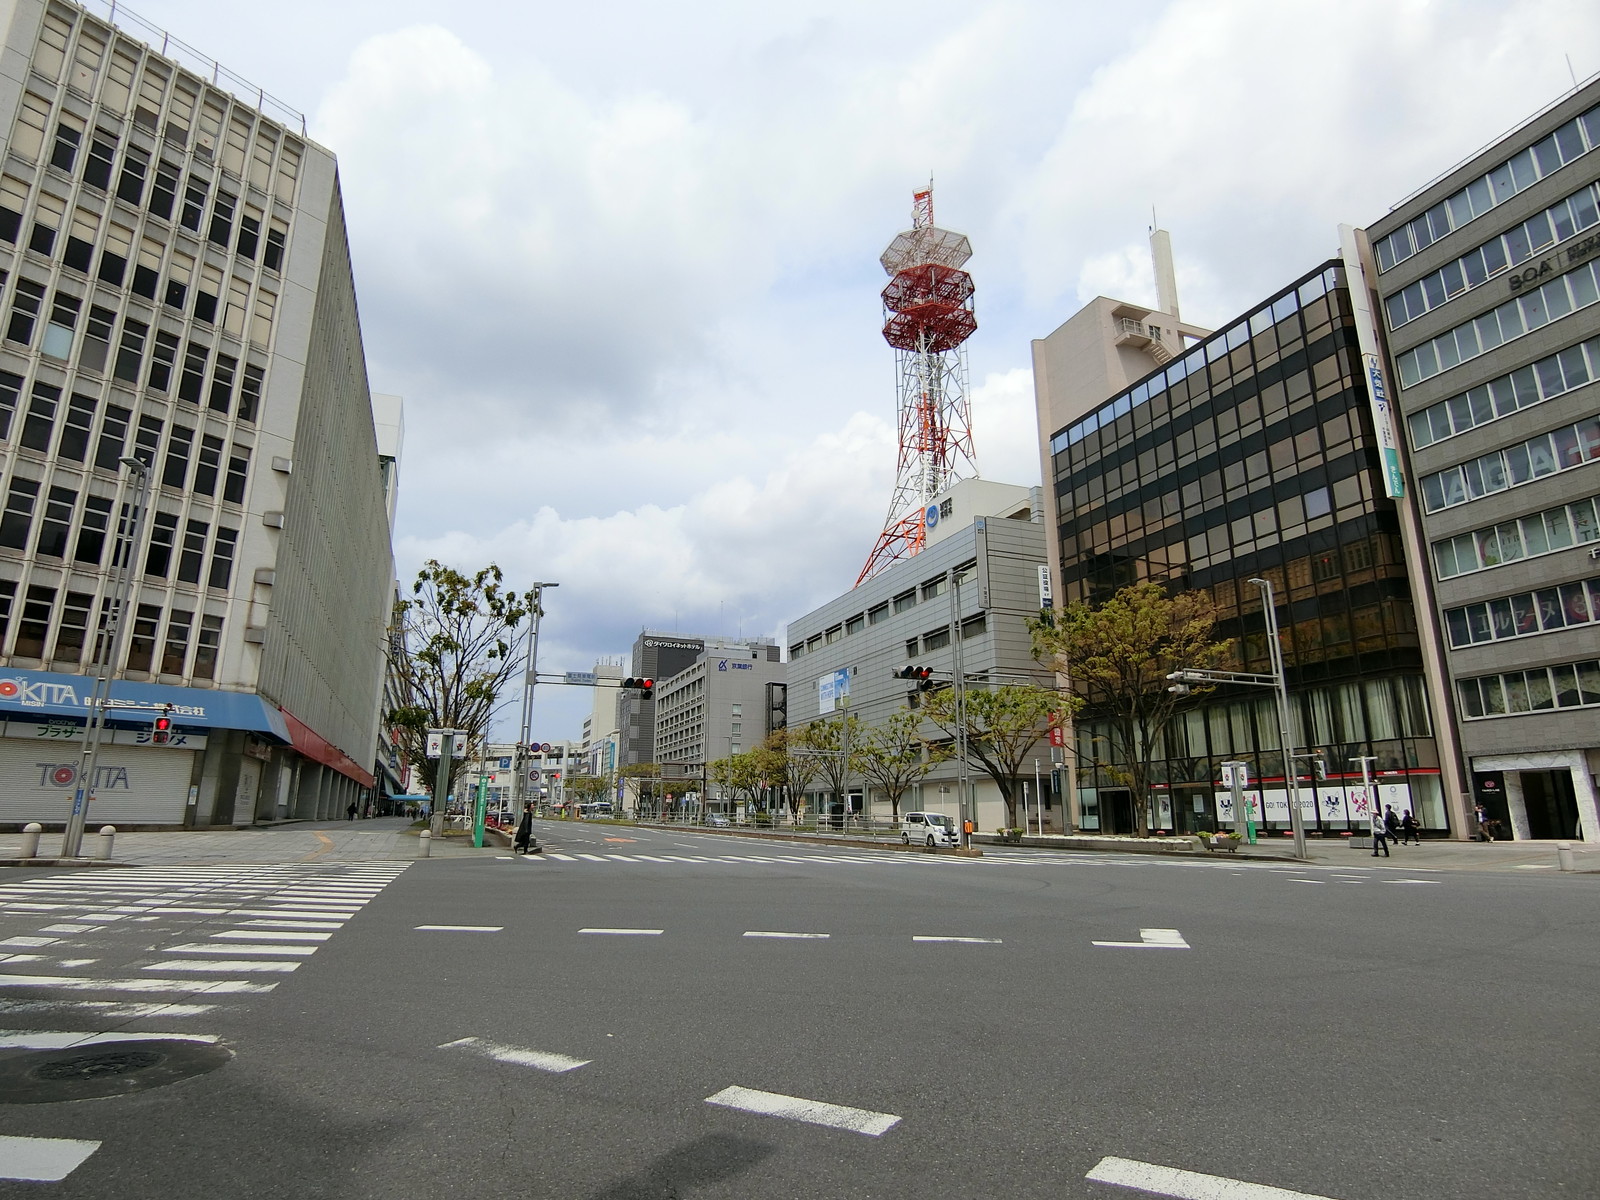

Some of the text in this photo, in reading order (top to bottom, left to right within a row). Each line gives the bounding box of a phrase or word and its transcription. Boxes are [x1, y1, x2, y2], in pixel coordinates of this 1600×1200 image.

[37, 725, 84, 739] ブラザー
[136, 732, 187, 746] ジノメ
